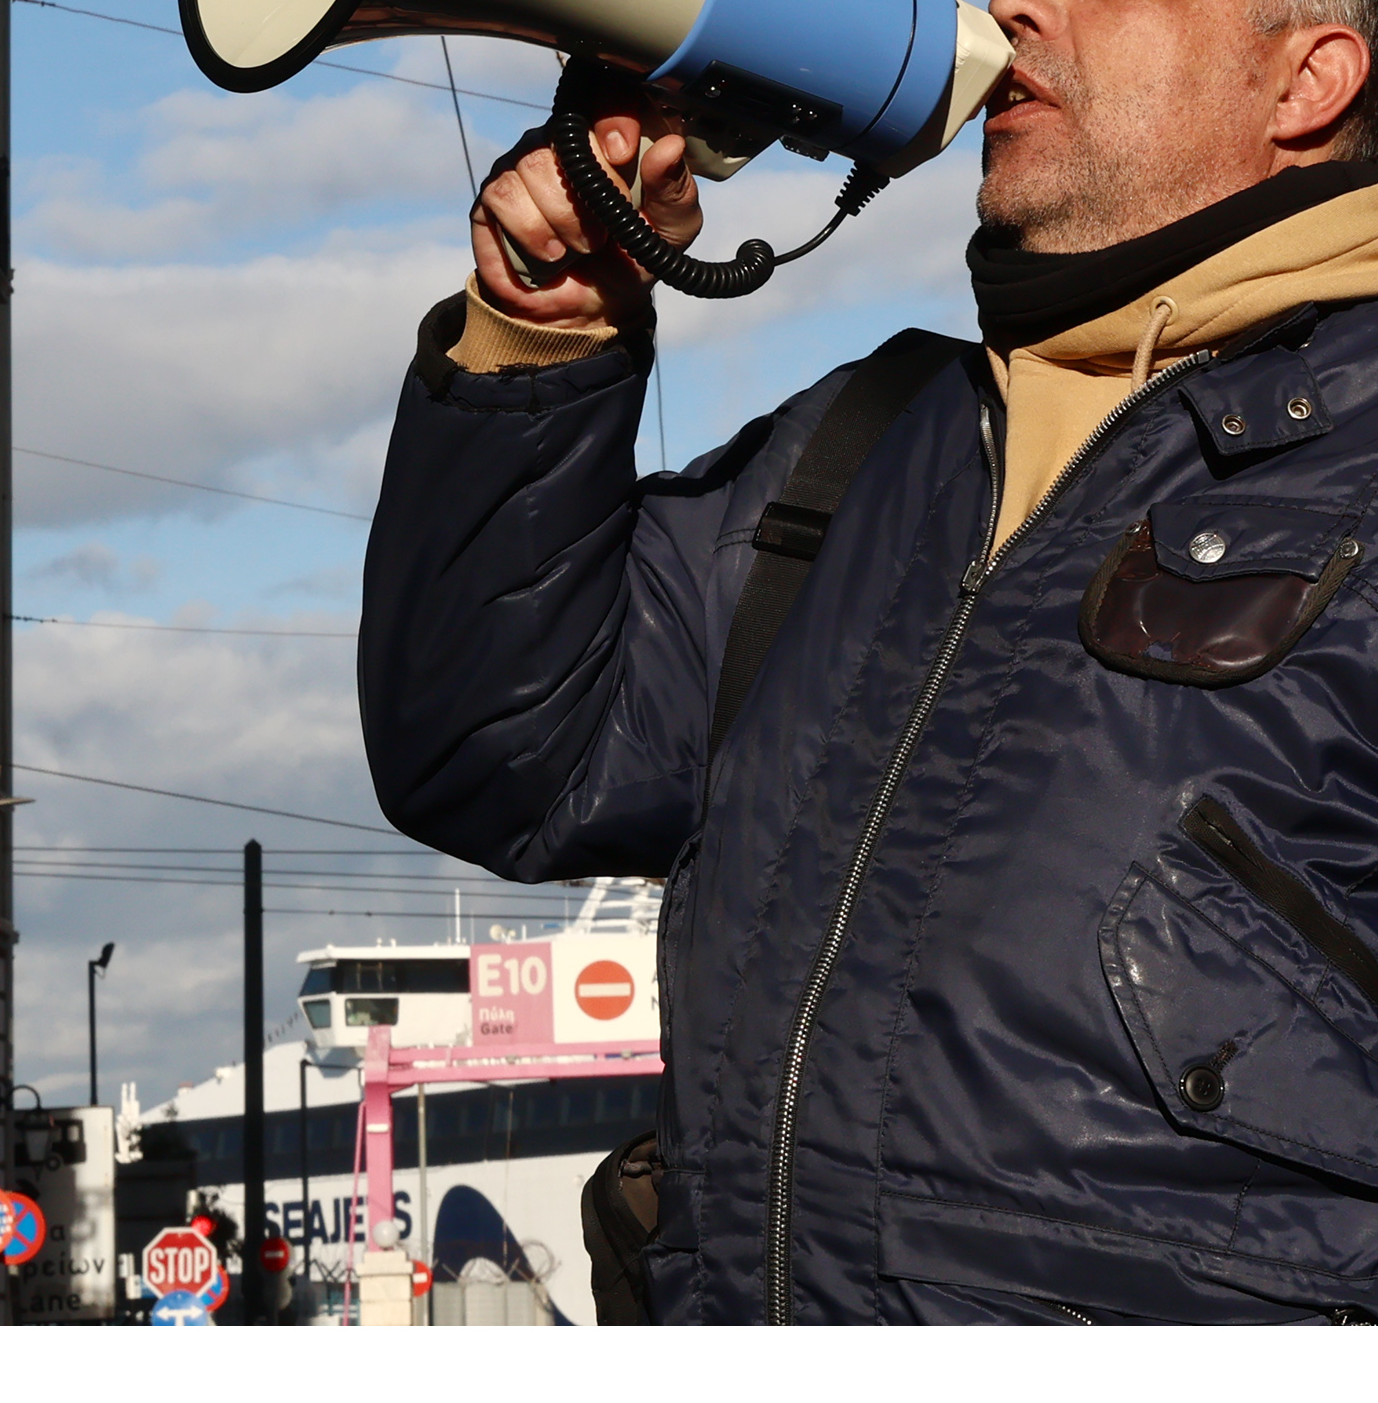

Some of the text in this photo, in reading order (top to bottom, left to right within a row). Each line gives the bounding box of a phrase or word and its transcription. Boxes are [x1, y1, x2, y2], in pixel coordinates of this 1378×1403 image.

[477, 954, 548, 997] E10
[479, 1005, 515, 1023] Πύλη
[480, 1023, 514, 1036] Gate
[263, 1190, 412, 1246] SEAJES
[23, 1251, 106, 1284] ρείων
[149, 1246, 211, 1285] STOP
